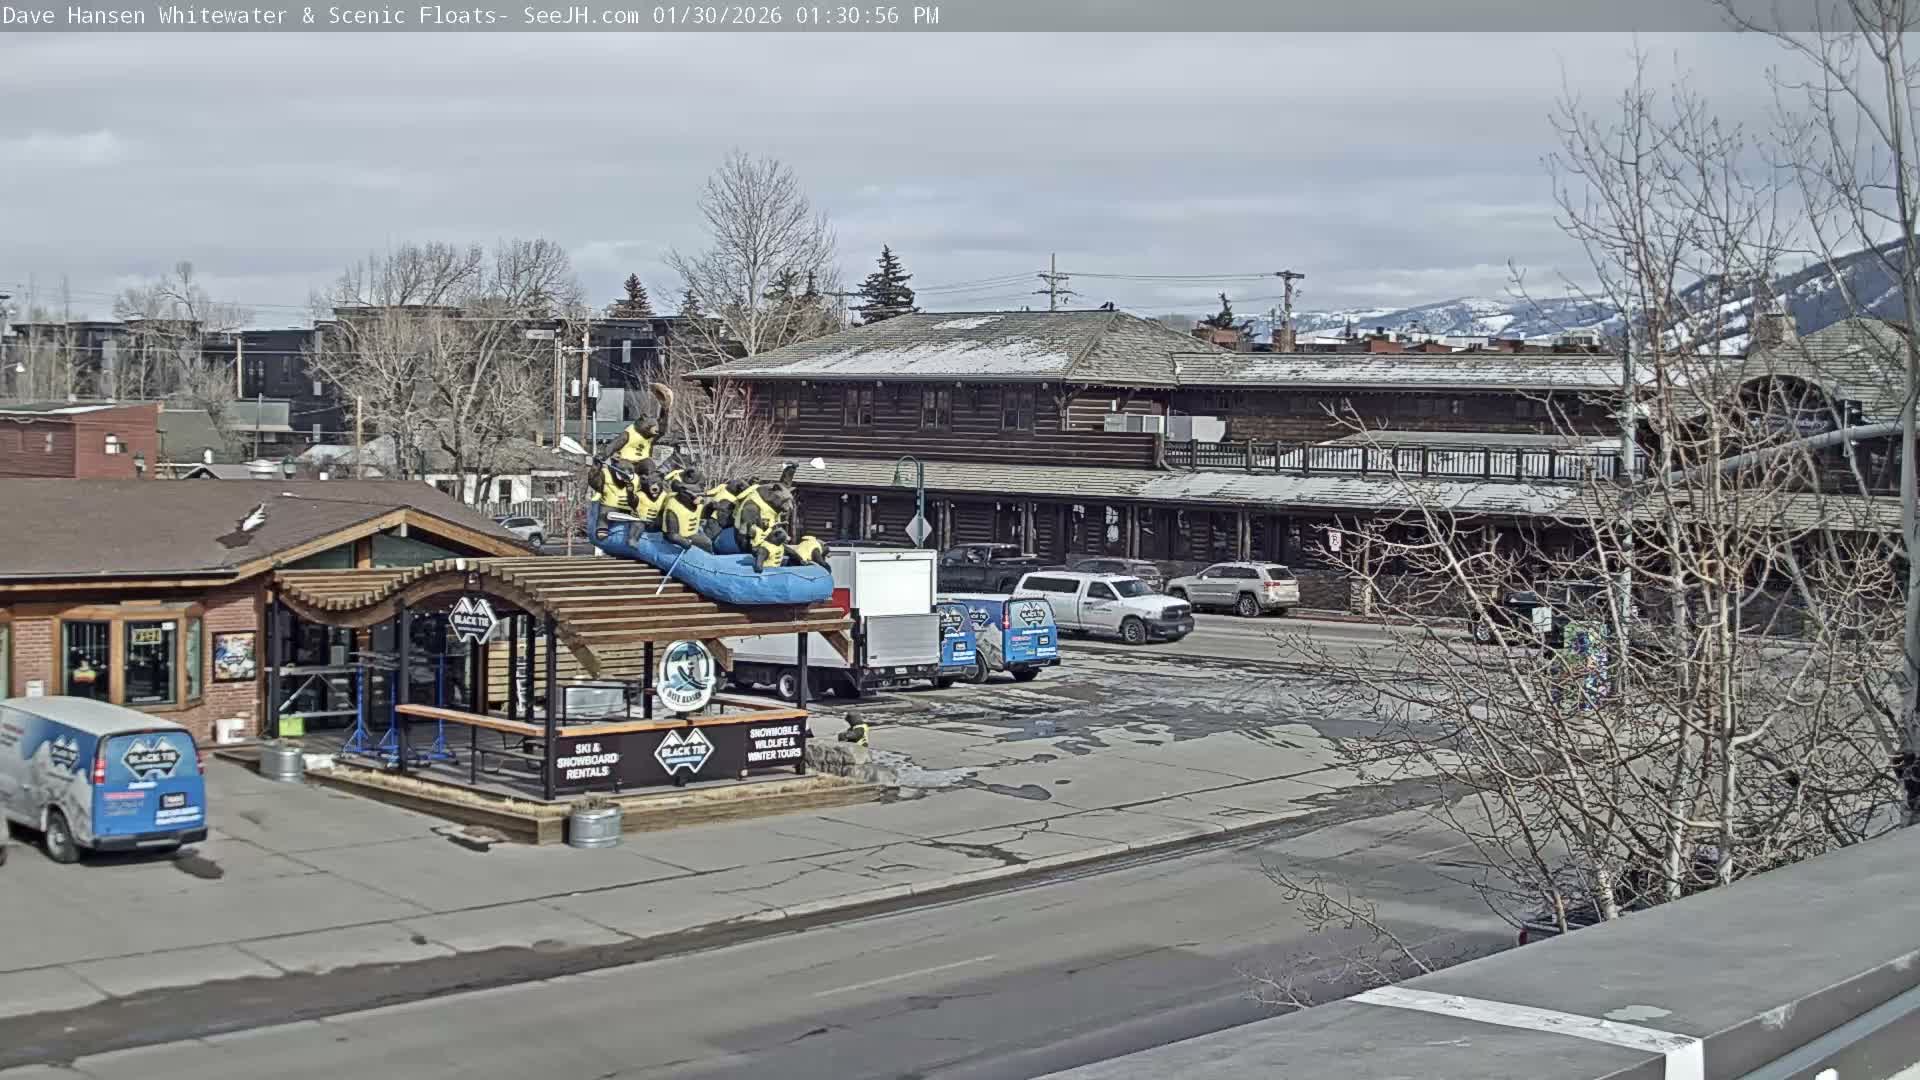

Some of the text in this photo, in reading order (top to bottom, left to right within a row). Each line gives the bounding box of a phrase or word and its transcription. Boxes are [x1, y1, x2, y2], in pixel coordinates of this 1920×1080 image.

[454, 614, 490, 628] BLACK TIE
[750, 725, 801, 738] SNOWMOBILE,
[575, 742, 601, 755] SKI &
[661, 744, 707, 758] BLACK TIE
[755, 738, 796, 750] WILDLIFE &
[128, 752, 177, 764] BLACK TIE
[556, 752, 620, 769] SNOWBOARD
[748, 747, 802, 762] WINTER TOURS
[566, 765, 610, 780] RENTALS
